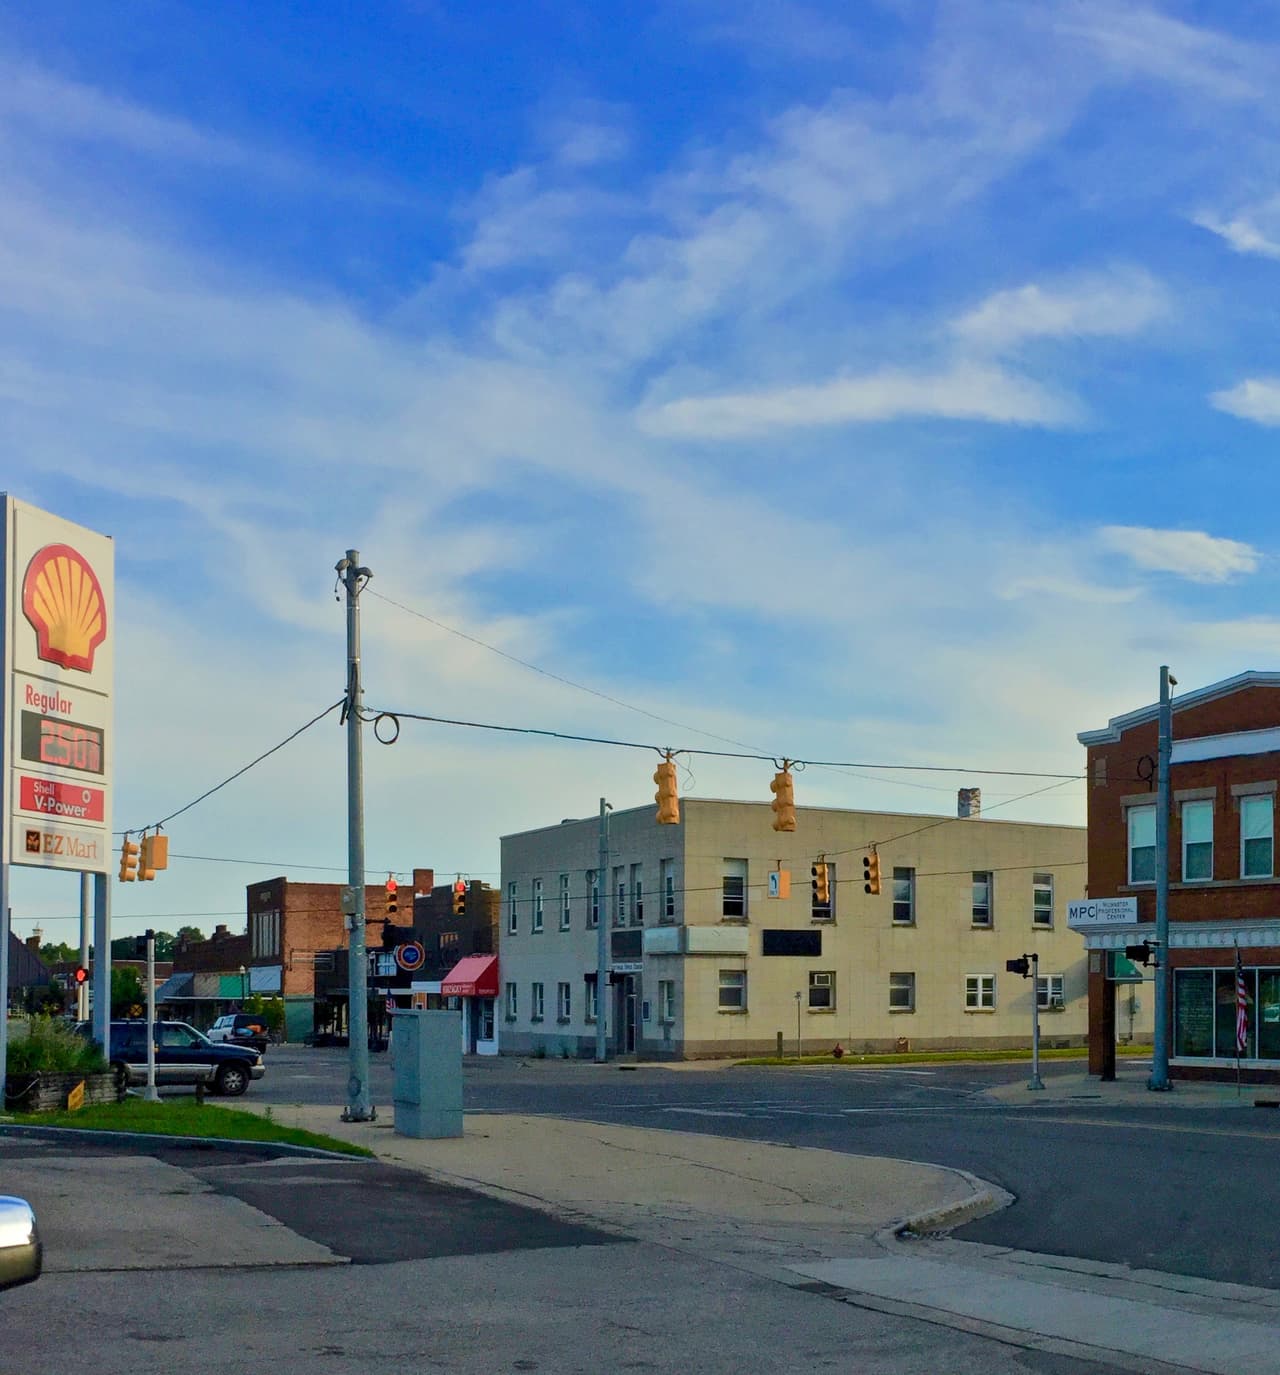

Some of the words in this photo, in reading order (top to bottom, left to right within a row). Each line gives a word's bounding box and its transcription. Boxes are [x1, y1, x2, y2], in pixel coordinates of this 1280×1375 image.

[25, 684, 72, 715] Regular
[33, 781, 55, 795] Shell
[34, 794, 87, 817] V-Power
[43, 833, 63, 855] EZ
[66, 836, 97, 859] Mart
[1069, 906, 1096, 919] MPC
